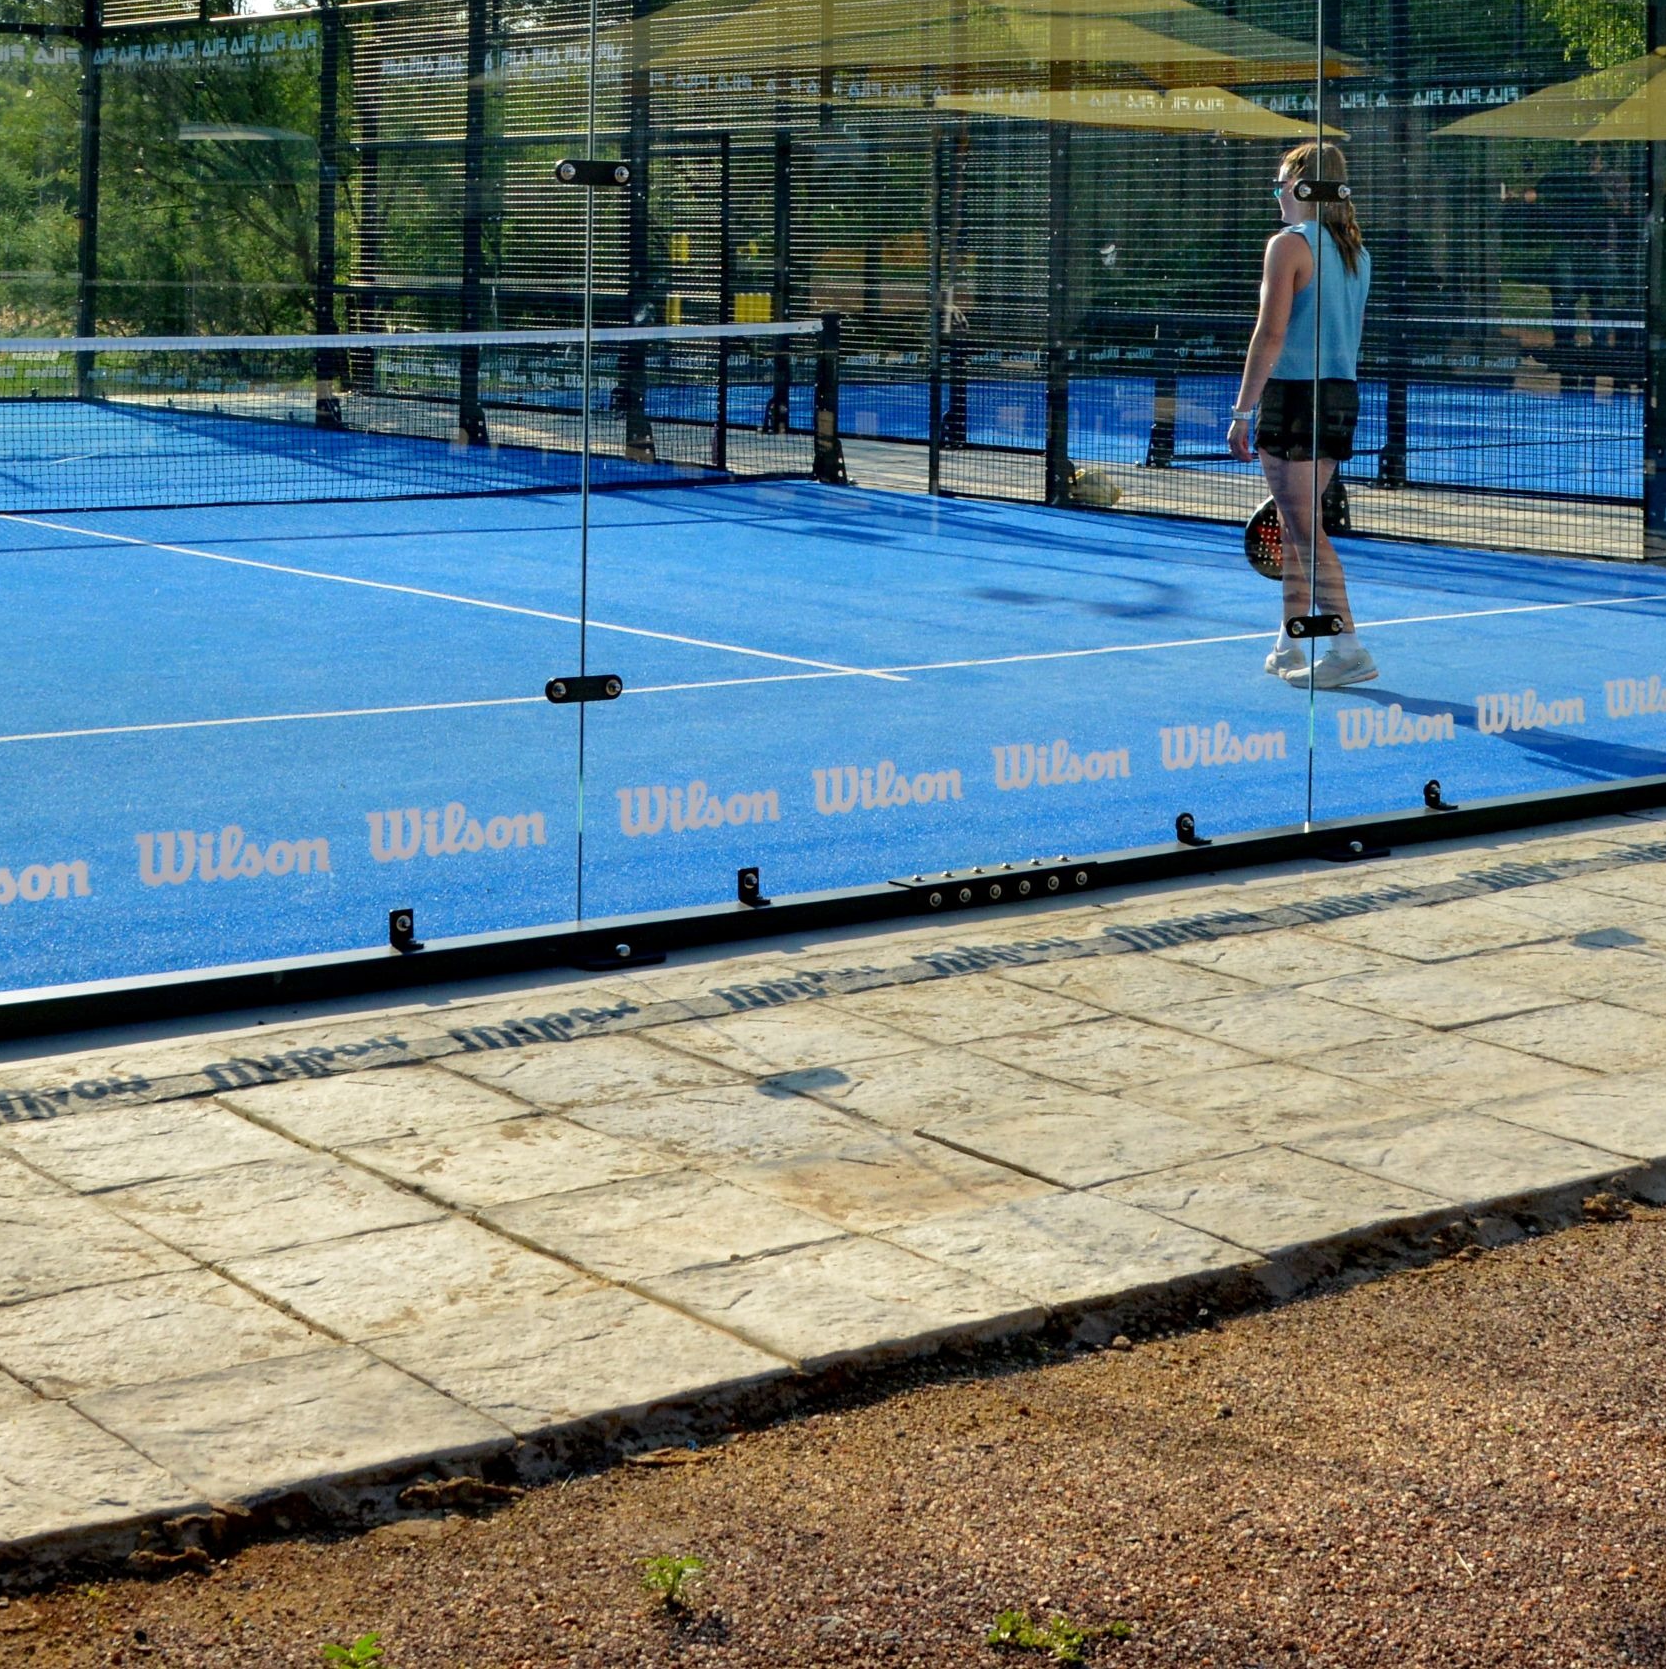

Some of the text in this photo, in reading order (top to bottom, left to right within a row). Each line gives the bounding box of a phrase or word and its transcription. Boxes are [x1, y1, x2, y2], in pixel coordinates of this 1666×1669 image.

[1338, 704, 1454, 750] Wilson
[1477, 689, 1584, 734] Wilson
[617, 721, 1286, 837] Wilson Wilson Wilson Wilson
[136, 825, 330, 885] Wilson
[366, 802, 545, 862] Wilson
